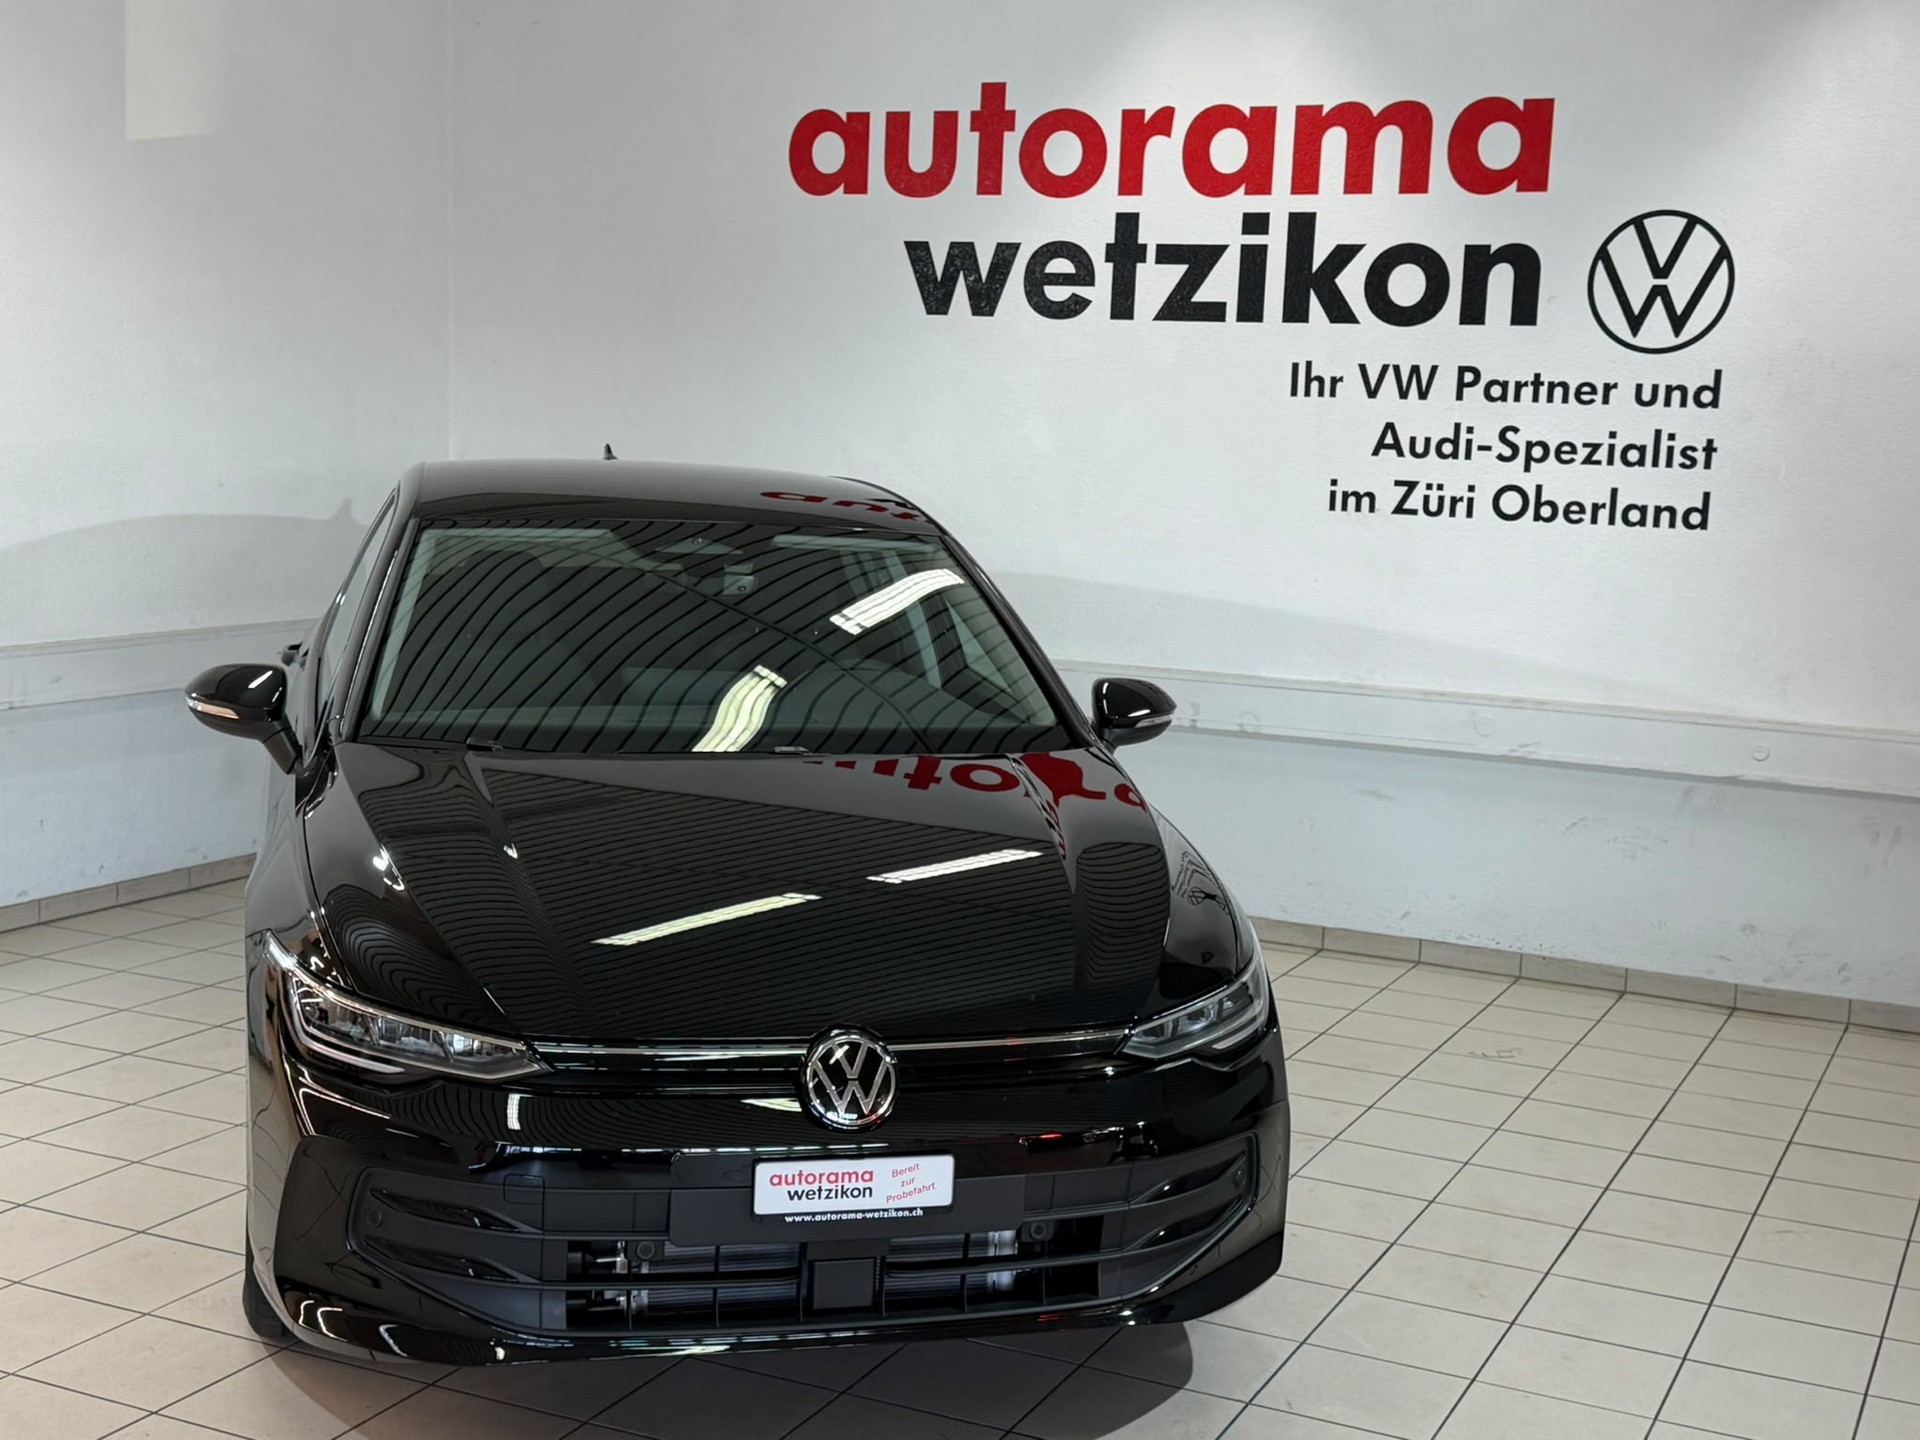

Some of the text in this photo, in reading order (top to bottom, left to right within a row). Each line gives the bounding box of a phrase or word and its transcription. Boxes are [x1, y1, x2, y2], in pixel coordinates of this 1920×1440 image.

[789, 82, 1555, 198] autorama
[903, 212, 1542, 327] wetzikon
[1290, 361, 1723, 409] Ihr VW Partner und
[1371, 422, 1718, 472] Audi-Spezialist
[1329, 479, 1711, 530] im Züri Oberland
[769, 1170, 874, 1186] autorama
[891, 1163, 920, 1178] Bereit
[885, 1182, 936, 1204] Probefahrt
[901, 1177, 915, 1187] zur
[787, 1185, 873, 1202] wetzikon
[785, 1208, 923, 1222] www.autorama-wetzikon.ch
